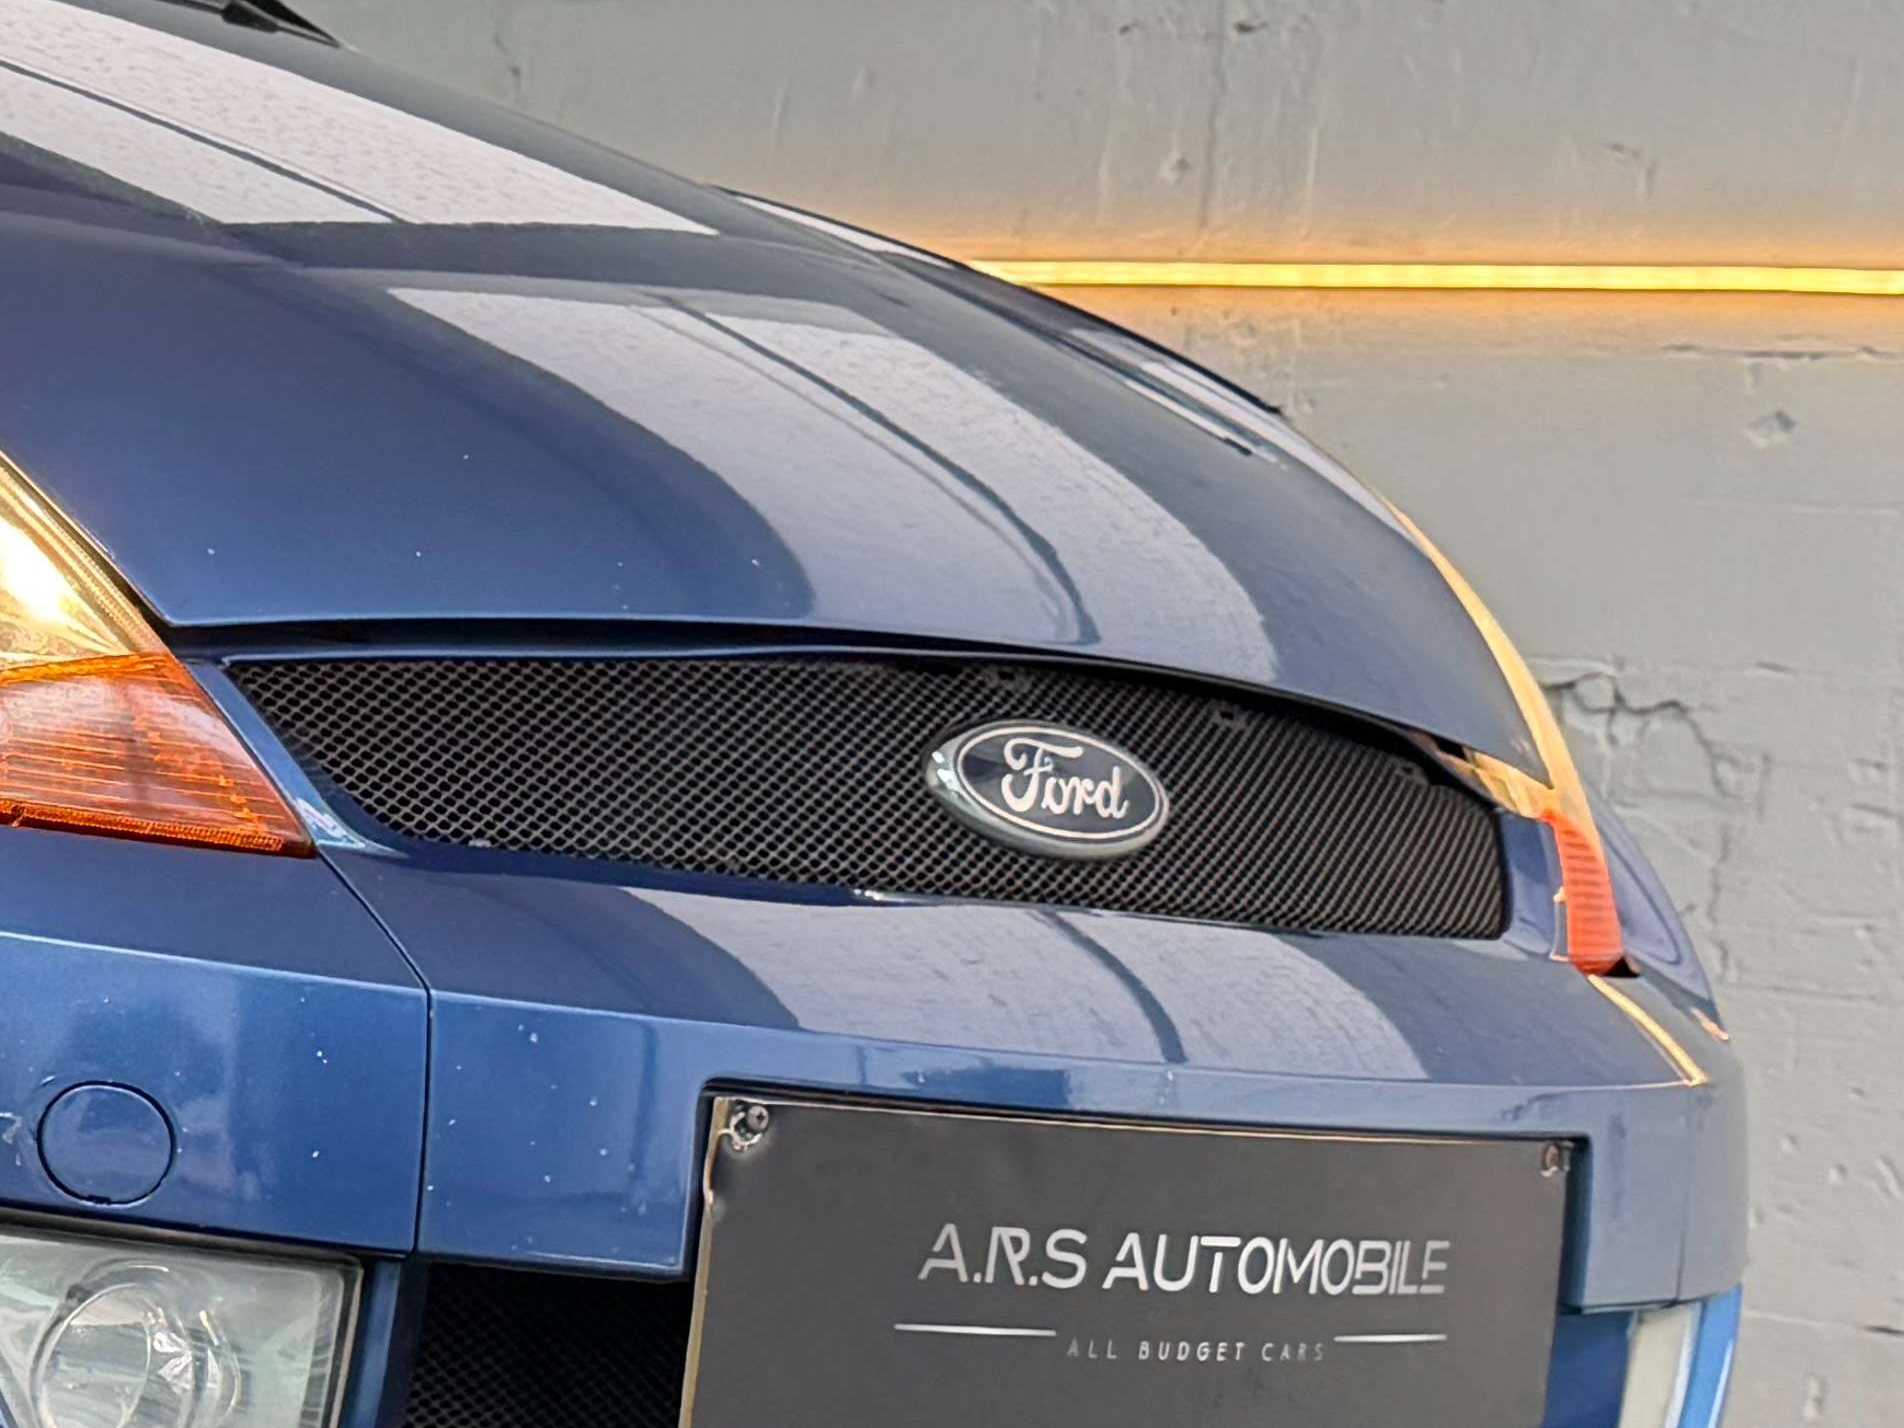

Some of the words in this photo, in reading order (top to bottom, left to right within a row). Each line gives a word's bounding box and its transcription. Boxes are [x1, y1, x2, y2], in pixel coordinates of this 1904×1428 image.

[1000, 737, 1129, 819] Ford
[917, 1222, 1088, 1289] A.R.S
[1101, 1232, 1451, 1296] AUTOMOBILE
[1066, 1336, 1118, 1360] ALL
[1138, 1340, 1245, 1362] BUDGET
[1261, 1341, 1325, 1362] CARS
